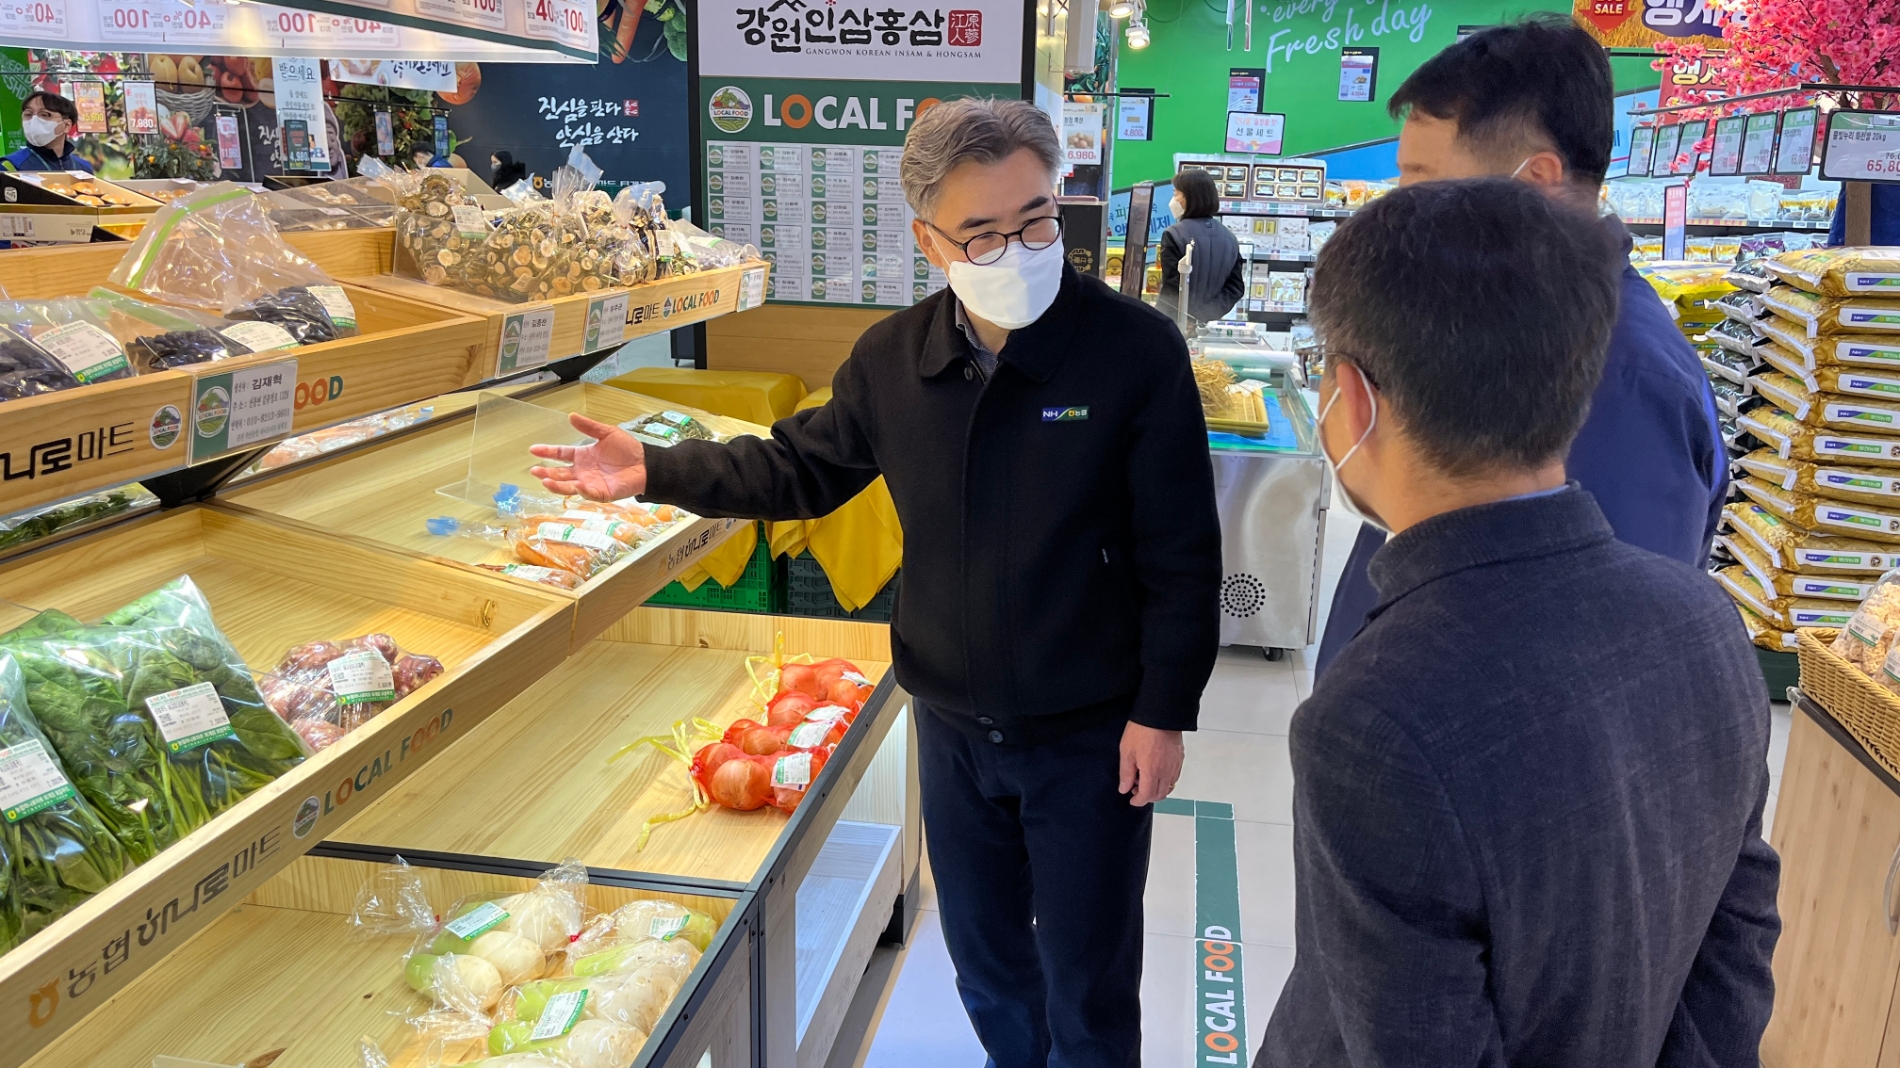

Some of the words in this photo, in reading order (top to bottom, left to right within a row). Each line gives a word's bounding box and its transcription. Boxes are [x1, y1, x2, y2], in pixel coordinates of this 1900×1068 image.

[1594, 3, 1622, 14] SALE
[1266, 8, 1364, 73] Fresh
[1371, 0, 1433, 43] day
[805, 48, 854, 56] GANGWON
[856, 49, 891, 57] KOREAN
[538, 97, 588, 123] 진심을
[590, 99, 621, 117] 판다
[763, 93, 888, 131] LOCAL
[556, 123, 604, 148] 안심을
[606, 126, 639, 144] 산다
[672, 295, 697, 314] LOCAL
[699, 290, 719, 308] FOOD
[252, 374, 282, 390] 김재혁
[295, 375, 344, 411] OOD
[1043, 410, 1058, 418] NH
[322, 749, 393, 816] LOCAL
[400, 708, 454, 762] FOOD
[68, 930, 132, 999] 농협
[137, 825, 281, 948] 하나로마트
[1203, 925, 1235, 983] FOOD
[1204, 989, 1239, 1066] LOCAL
